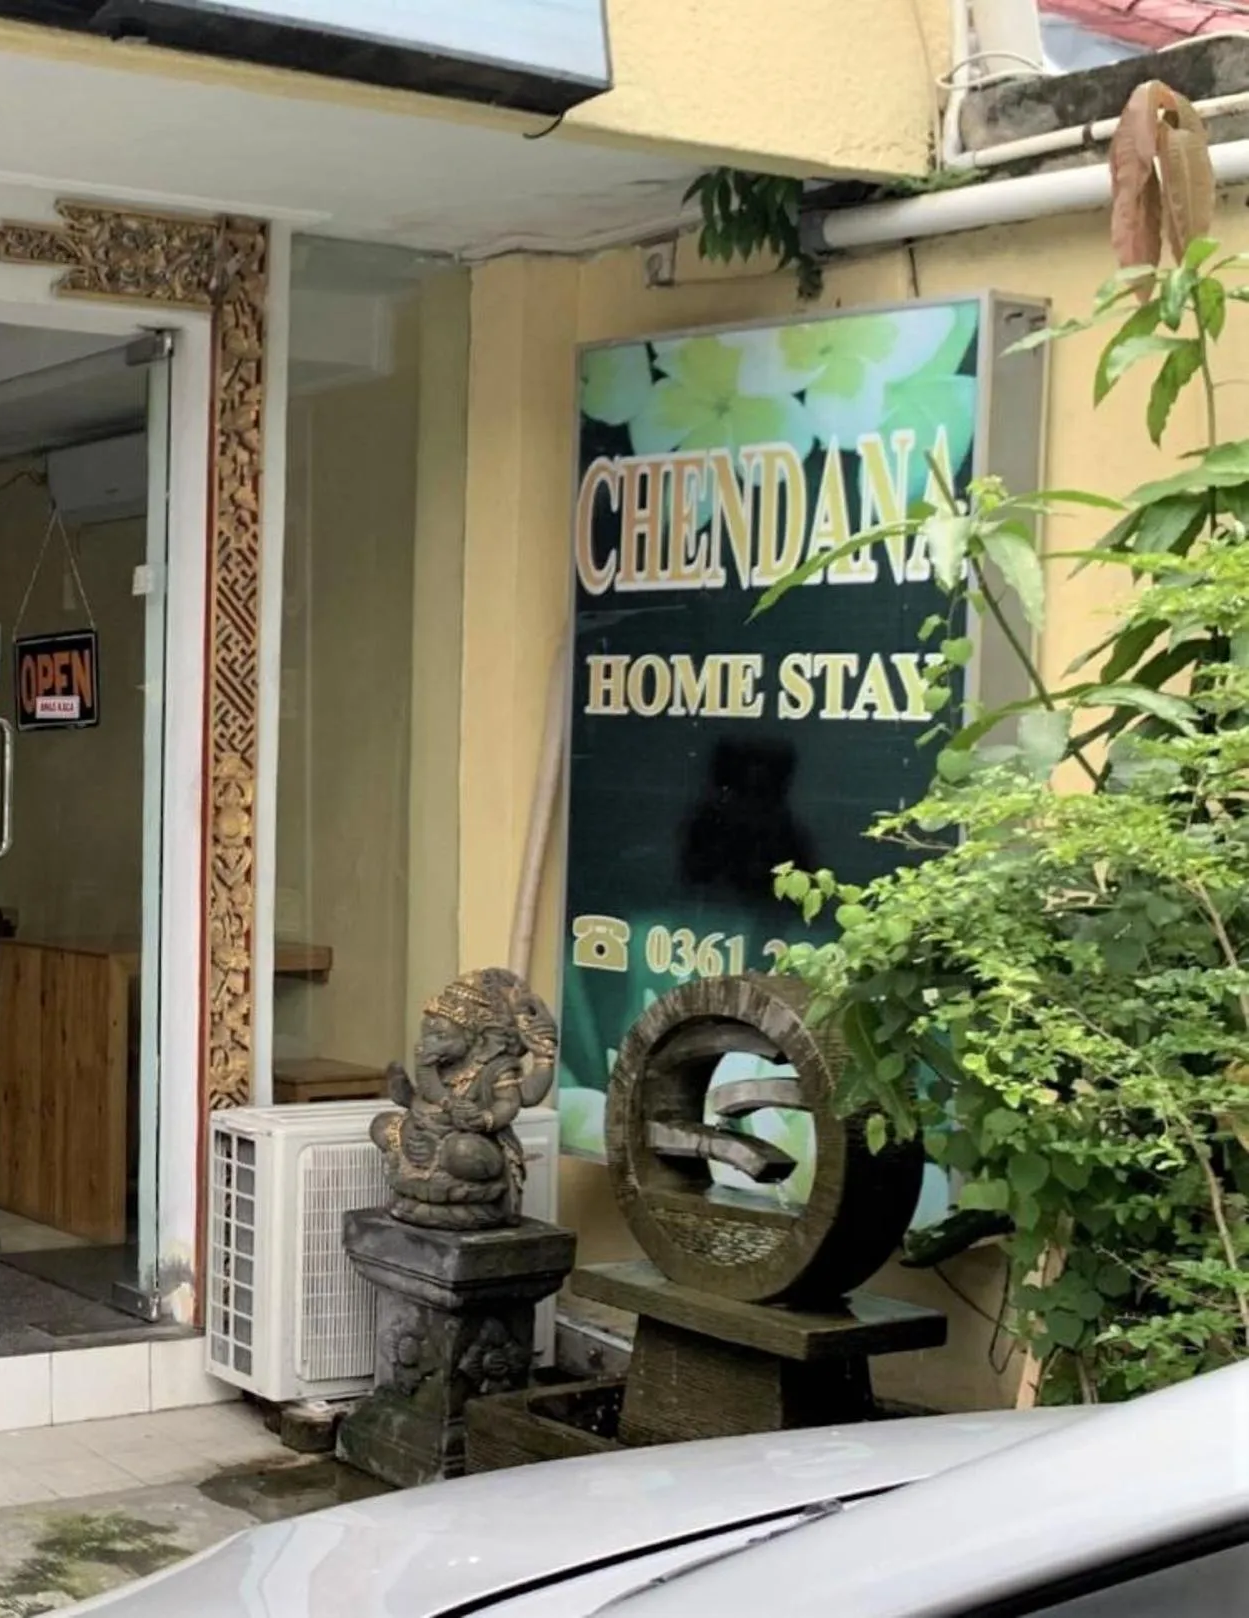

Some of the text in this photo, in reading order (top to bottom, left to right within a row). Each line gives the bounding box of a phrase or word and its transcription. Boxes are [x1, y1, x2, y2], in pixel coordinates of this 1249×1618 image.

[21, 650, 92, 714] OPEN
[585, 652, 947, 721] HOME STAY
[646, 924, 745, 978] 0361
